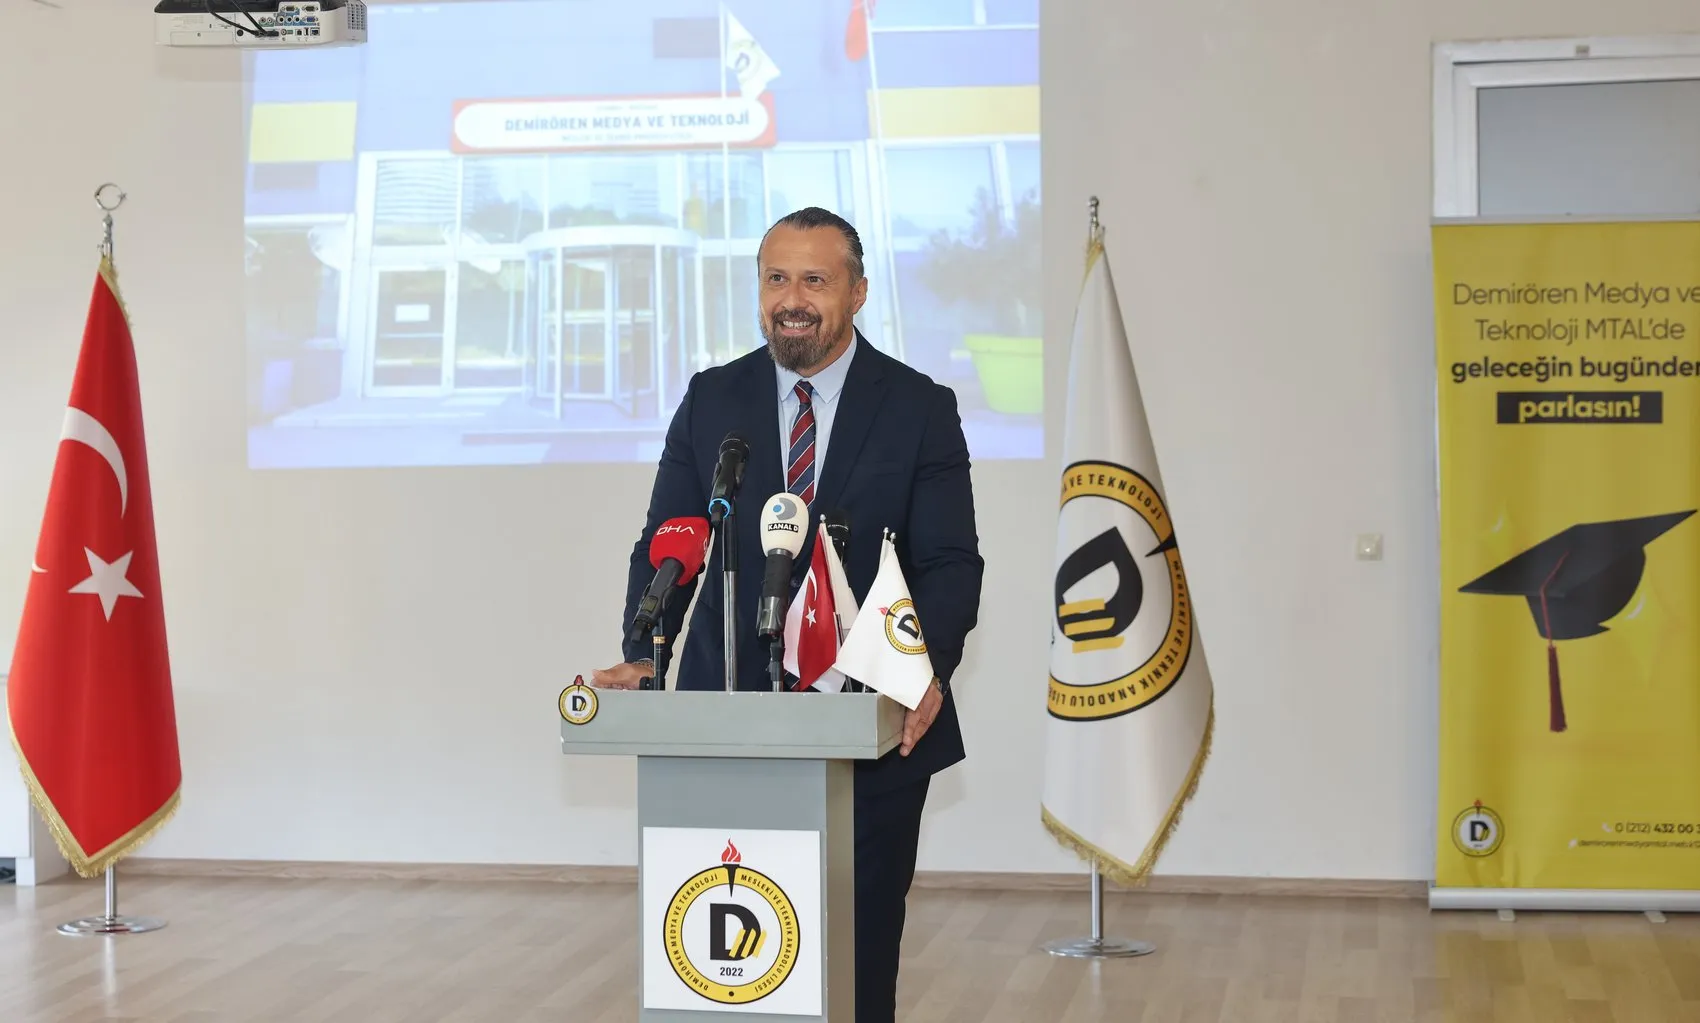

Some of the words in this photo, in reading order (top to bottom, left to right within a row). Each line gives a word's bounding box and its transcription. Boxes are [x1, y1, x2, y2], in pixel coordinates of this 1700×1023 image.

[505, 114, 587, 132] DEMİRÖREN
[592, 115, 641, 129] MEDYA
[647, 115, 665, 128] VE
[670, 110, 750, 127] TEKNOLOJİ
[1453, 282, 1578, 305] Demirören
[1584, 282, 1670, 309] Medya
[1475, 318, 1579, 346] Teknoloji
[1451, 355, 1572, 384] geleceğin
[1518, 394, 1641, 423] parlasın!
[1088, 473, 1163, 520] TEKNOLOJİ
[656, 525, 695, 536] DHA
[768, 522, 792, 531] KANAL
[1138, 648, 1179, 690] TEKNİK
[1069, 683, 1137, 708] ANADOLU
[1614, 822, 1624, 833] 0
[1626, 822, 1651, 834] (212)
[1654, 823, 1675, 833] 432
[1677, 823, 1694, 834] 00
[679, 873, 718, 904] TEKNOLOJİ
[740, 874, 775, 896] MESLEKİ
[673, 905, 682, 916] VE
[772, 894, 783, 905] VE
[670, 918, 678, 947] MEDYA
[779, 905, 793, 935] TEKNİK
[776, 937, 793, 975] ANADOLU
[673, 949, 709, 991] DEMİRÖREN
[719, 966, 744, 977] 2022
[754, 972, 778, 993] LİSESİ
